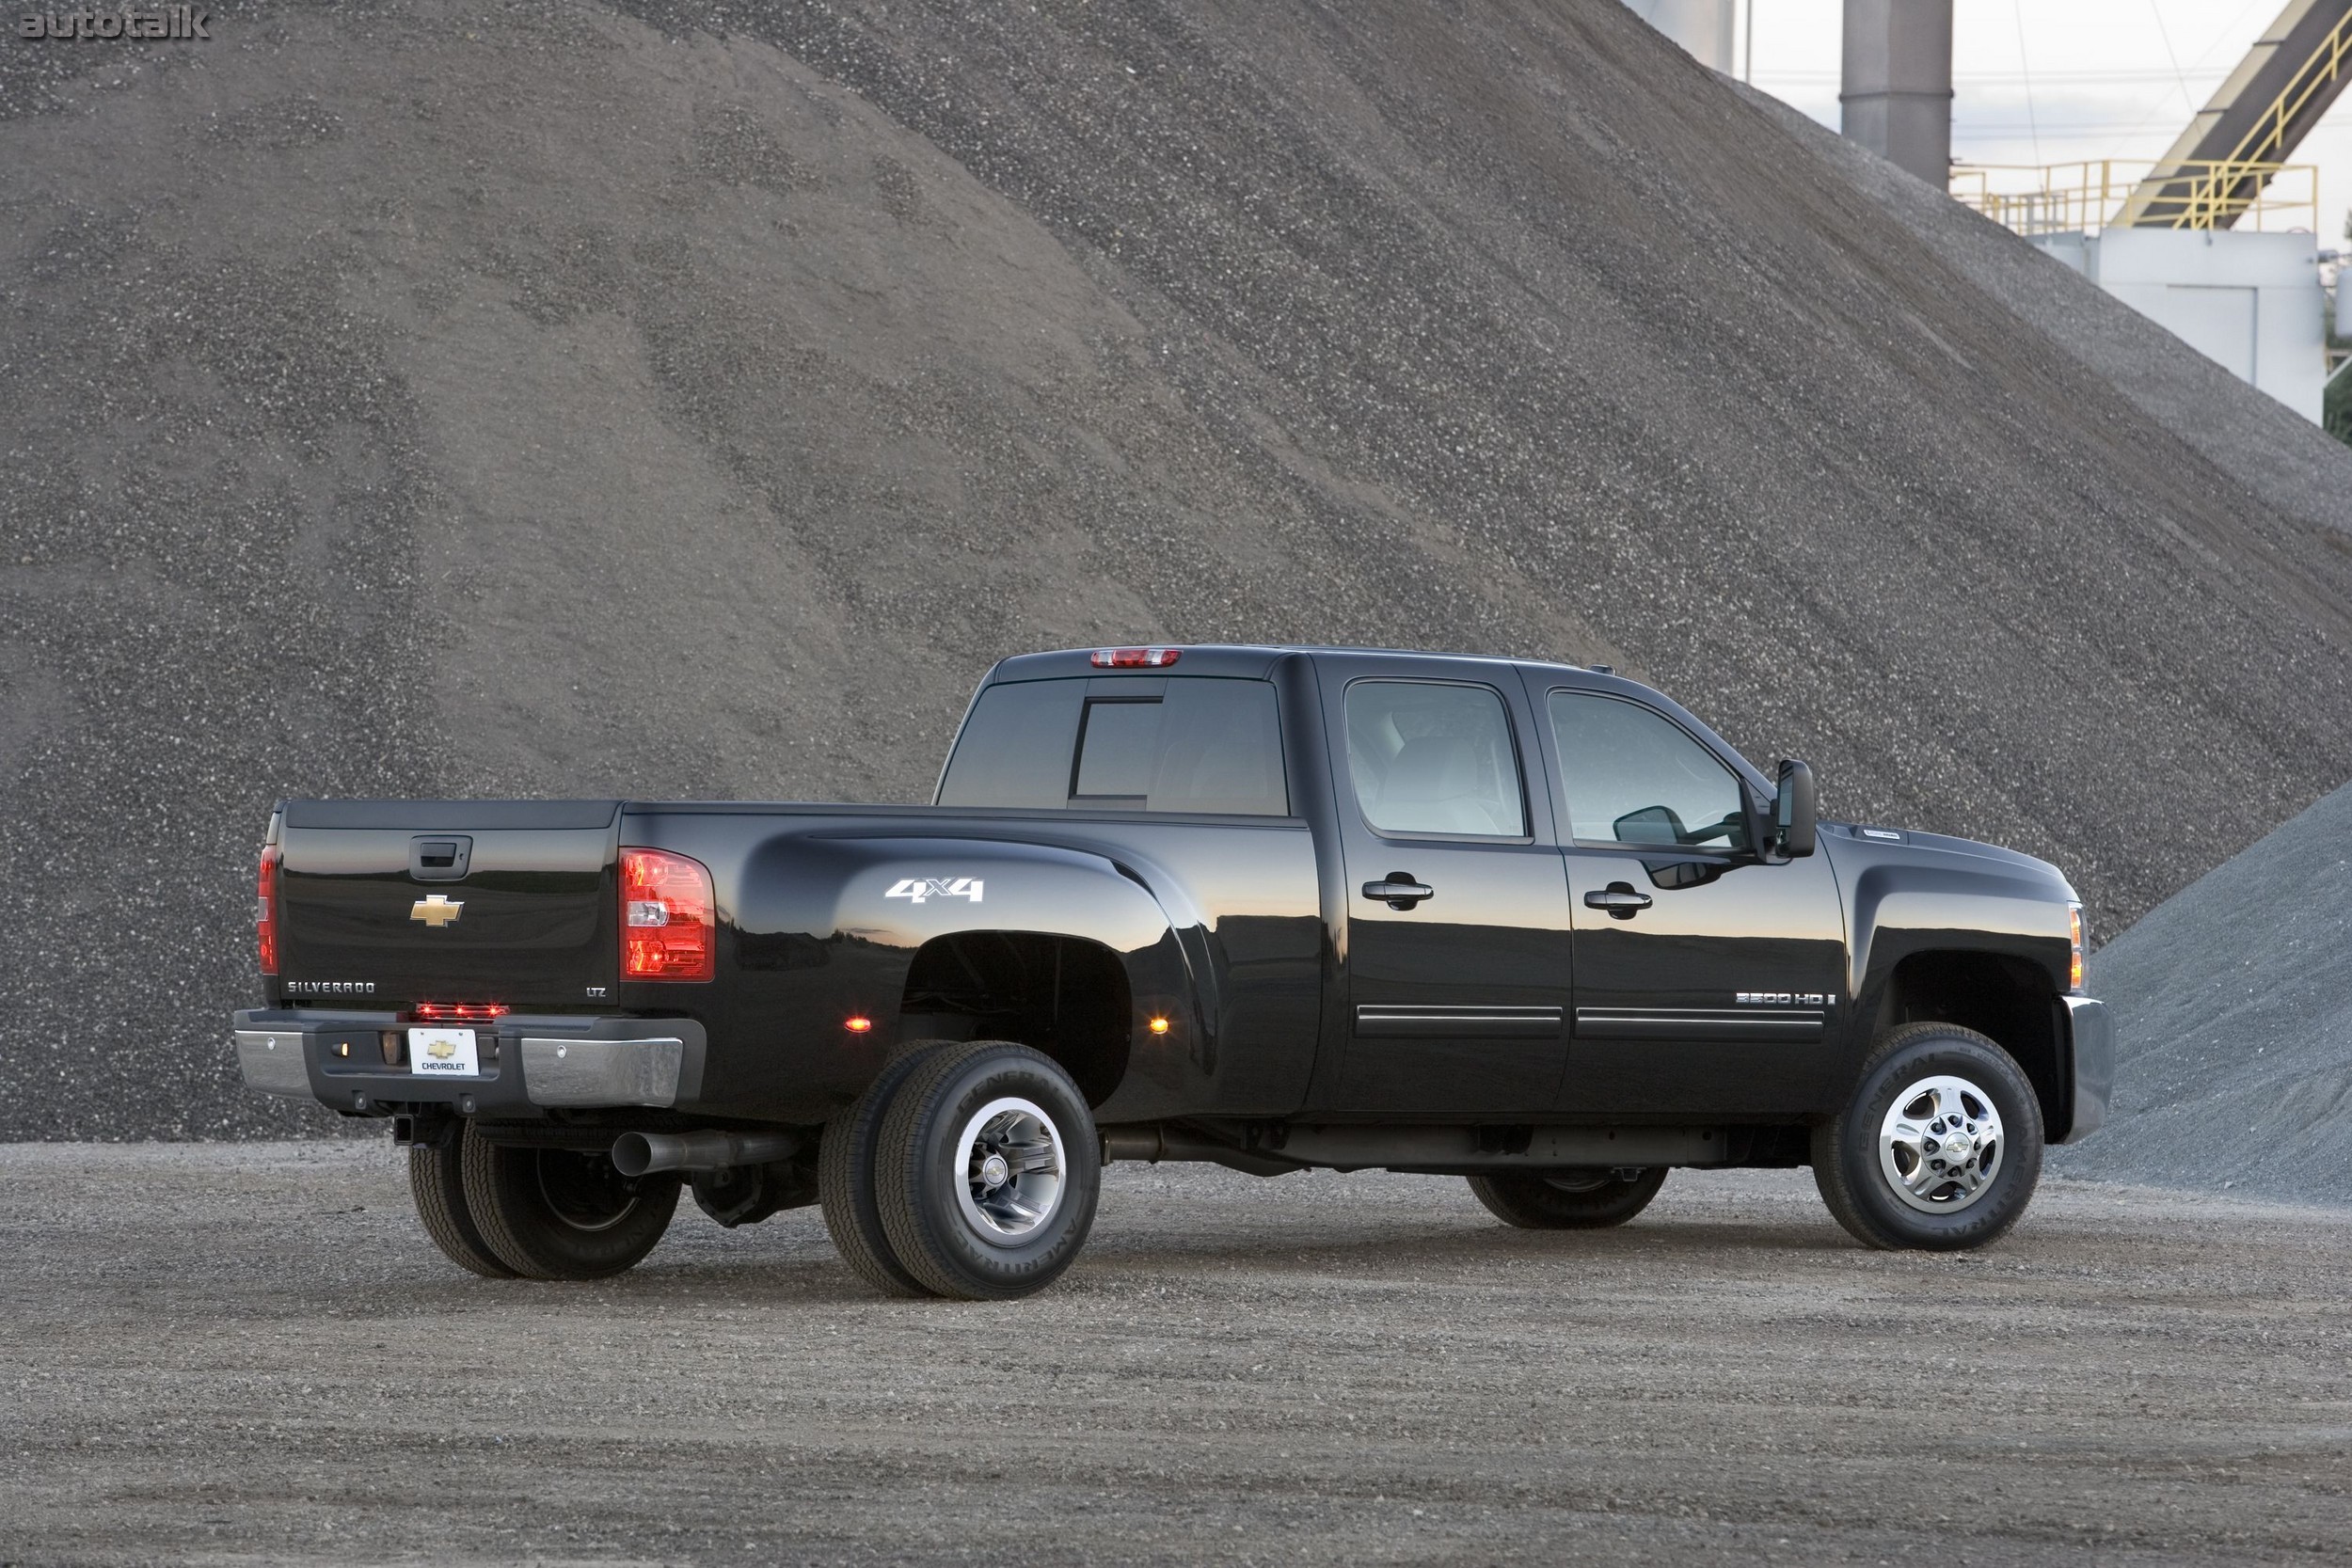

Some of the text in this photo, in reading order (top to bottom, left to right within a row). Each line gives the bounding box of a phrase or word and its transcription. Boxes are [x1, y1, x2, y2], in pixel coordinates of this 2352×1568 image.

[288, 981, 375, 994] SILVERADO
[586, 987, 607, 998] LTZ
[1736, 992, 1823, 1005] 3500 HD
[421, 1062, 466, 1071] CHEVROLET
